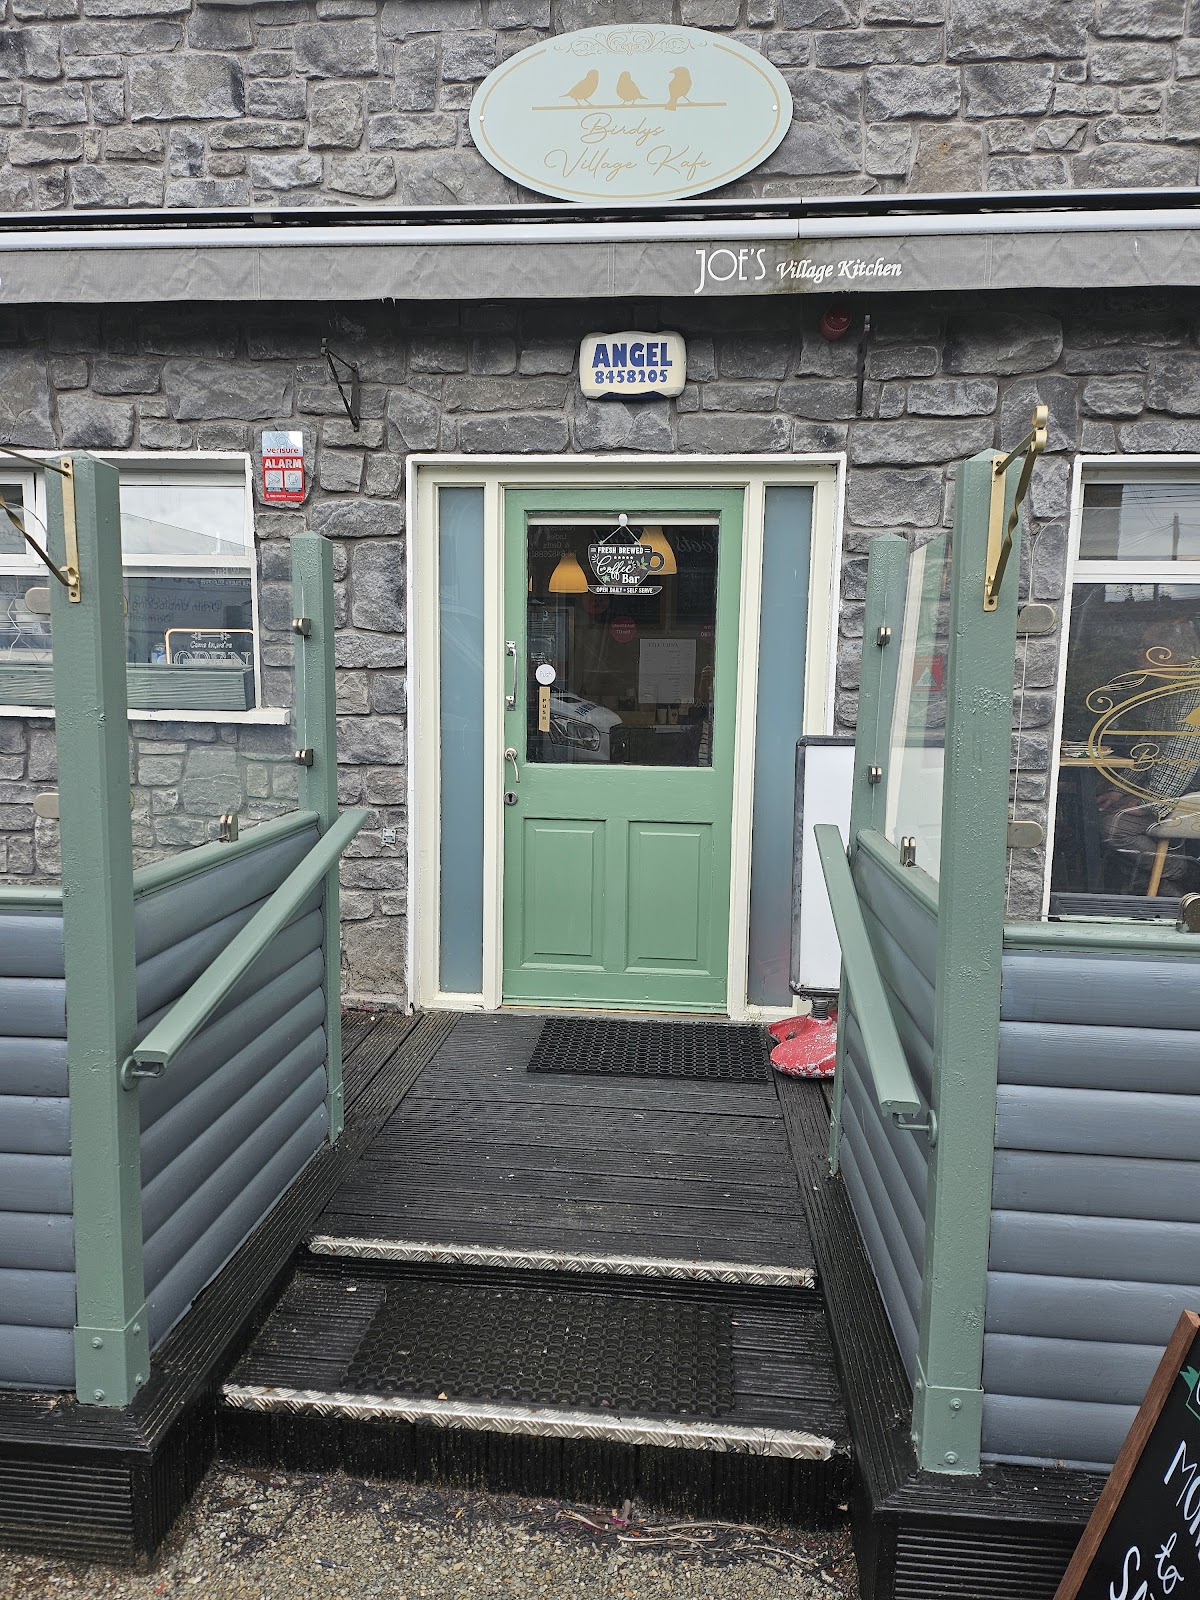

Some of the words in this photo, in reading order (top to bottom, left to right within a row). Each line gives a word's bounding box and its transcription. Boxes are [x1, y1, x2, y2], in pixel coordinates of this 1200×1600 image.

[580, 112, 666, 146] Birdys
[544, 148, 639, 182] Village
[646, 145, 712, 180] Kafe
[694, 248, 766, 294] JOE'S
[776, 259, 833, 283] Village
[837, 257, 902, 279] Kitchen
[592, 343, 673, 368] ANGEL
[595, 369, 668, 384] 8458205
[264, 458, 303, 469] ALARM
[597, 546, 617, 554] FRESH
[618, 546, 644, 554] BREWED
[596, 555, 635, 581] Coffee
[621, 573, 641, 584] Bar
